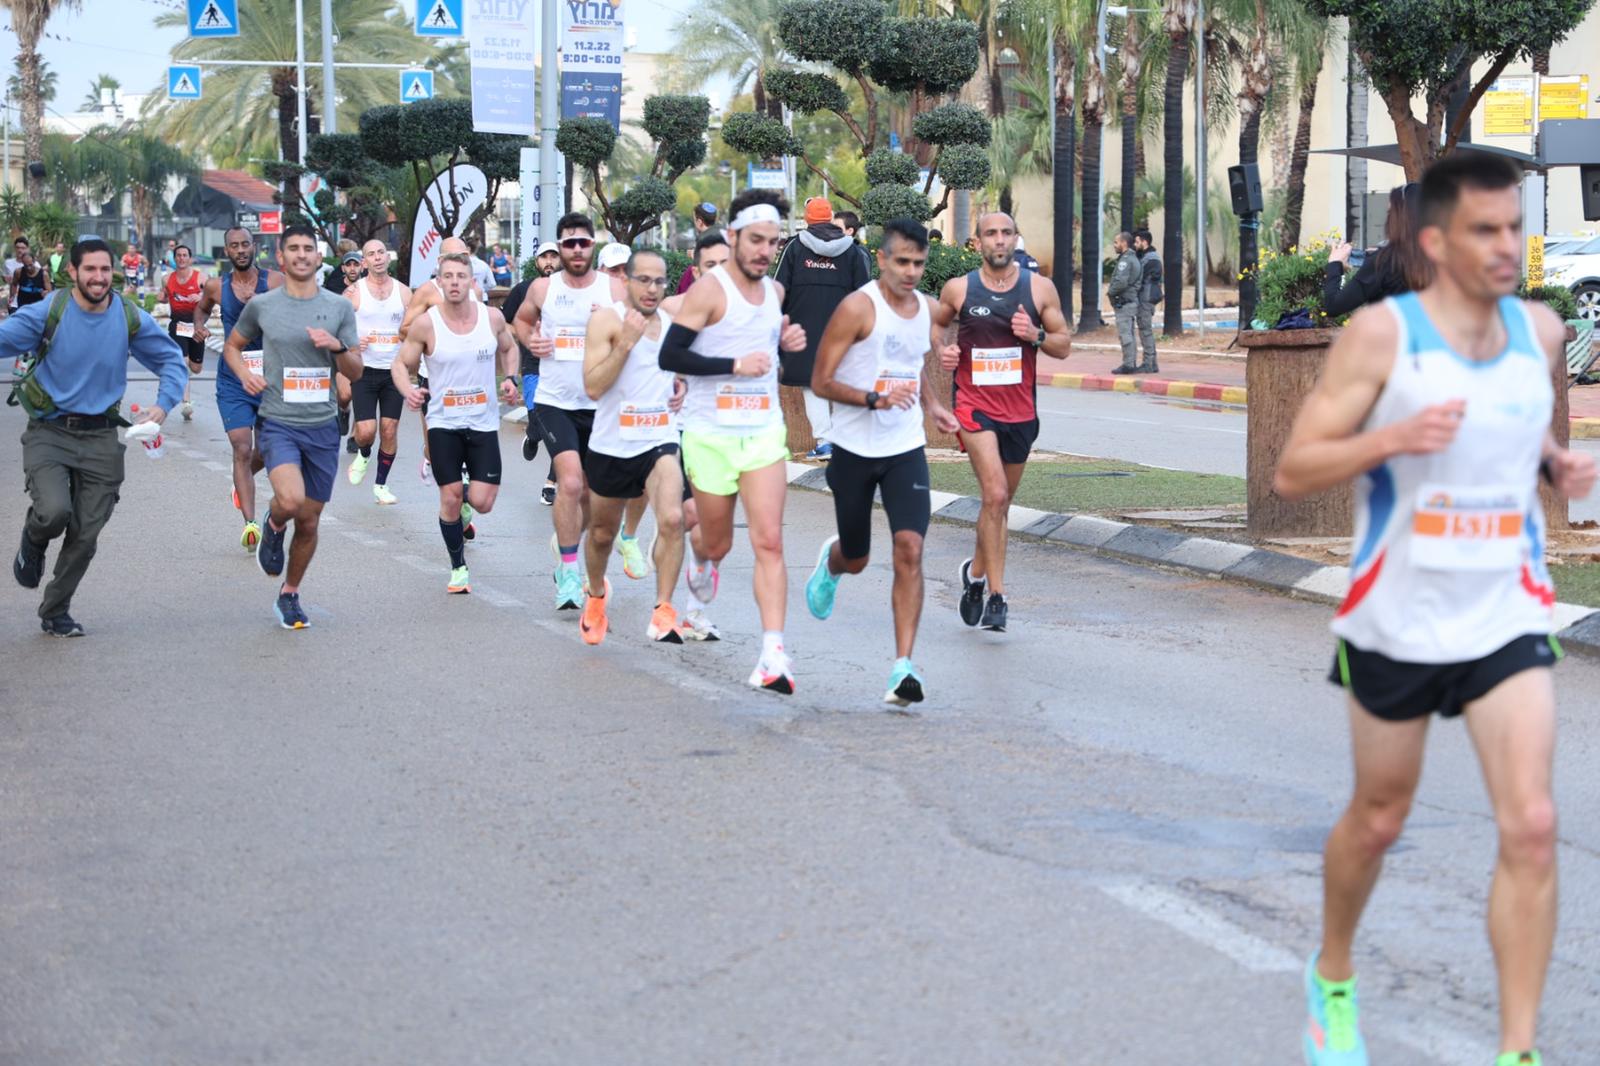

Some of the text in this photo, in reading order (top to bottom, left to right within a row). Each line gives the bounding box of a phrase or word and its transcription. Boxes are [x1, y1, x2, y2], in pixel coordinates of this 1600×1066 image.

[574, 41, 610, 51] 11.2.22
[563, 54, 621, 64] 9:00-6:00
[804, 258, 838, 270] YINGFA
[984, 360, 1011, 372] 1173
[296, 379, 321, 391] 1176
[633, 415, 661, 428] 1237
